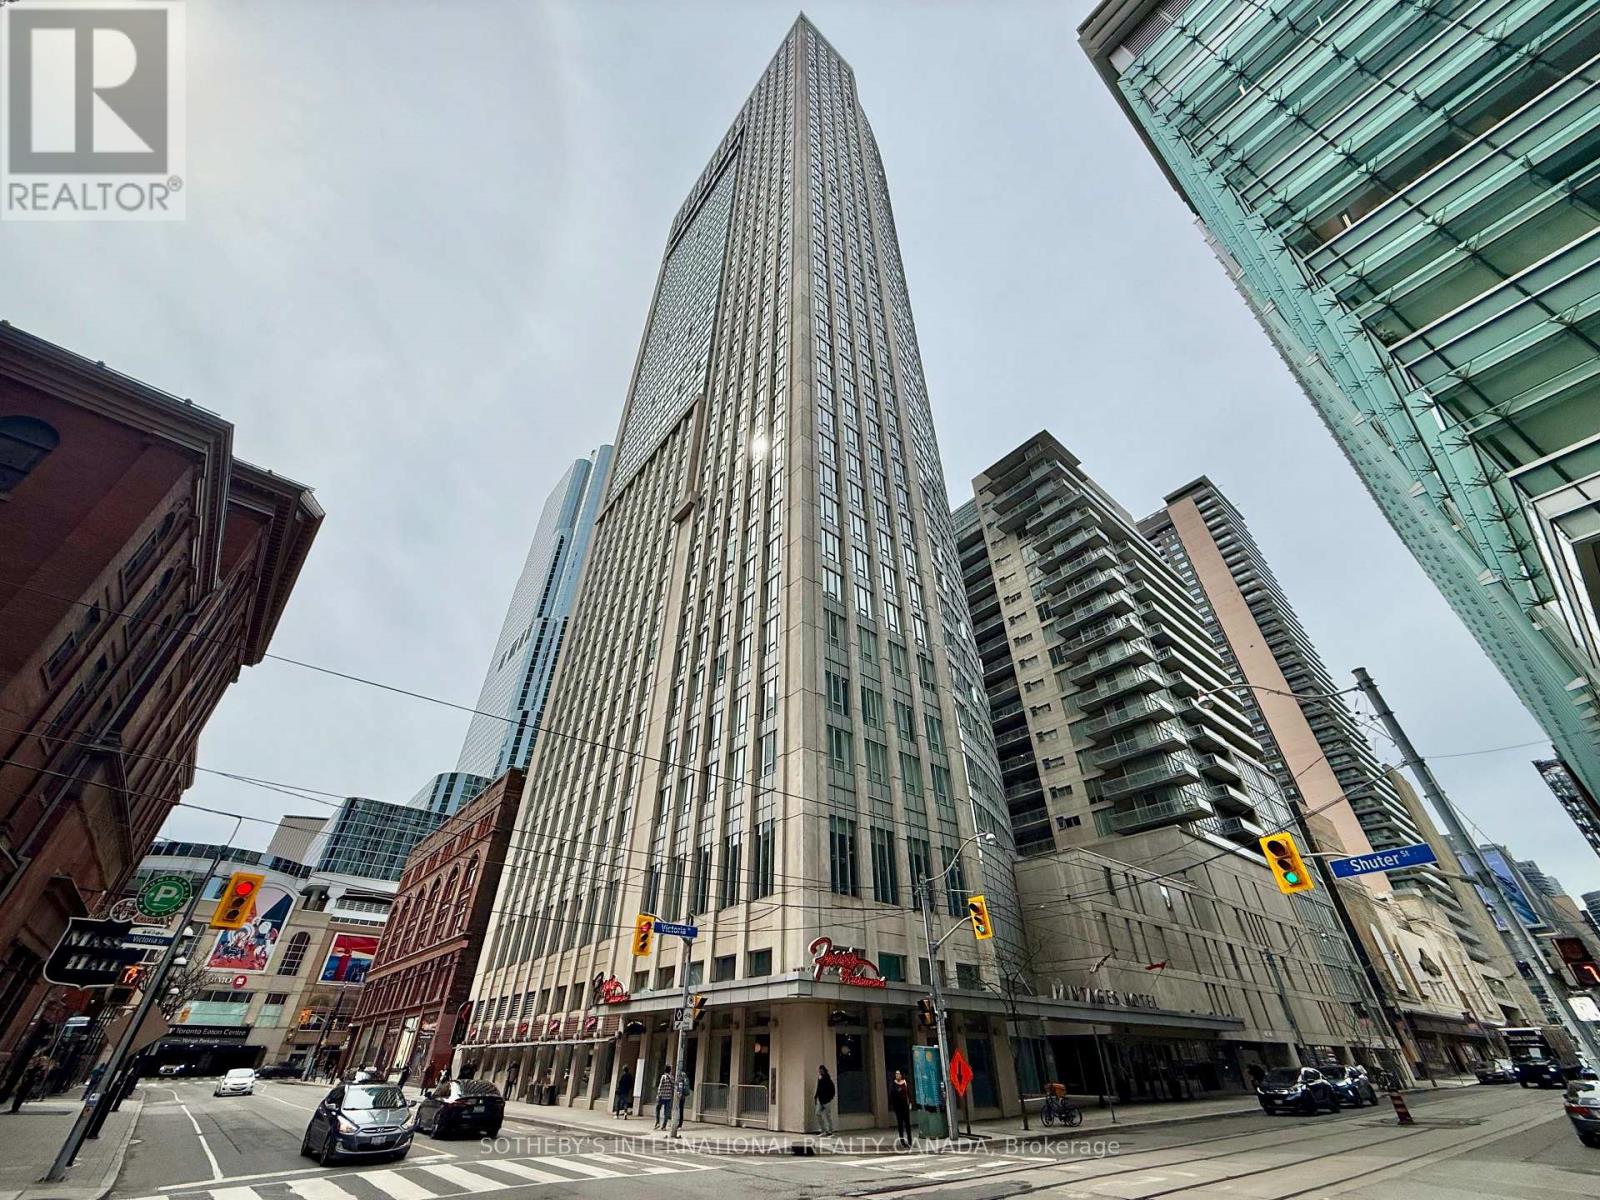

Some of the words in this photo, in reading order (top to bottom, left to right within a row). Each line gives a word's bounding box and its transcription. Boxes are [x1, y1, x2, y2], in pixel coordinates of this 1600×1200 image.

[1350, 854, 1400, 872] Shuter
[1400, 849, 1410, 857] St
[661, 924, 687, 935] Victoria
[65, 930, 122, 948] MASS
[132, 935, 158, 944] Victoria
